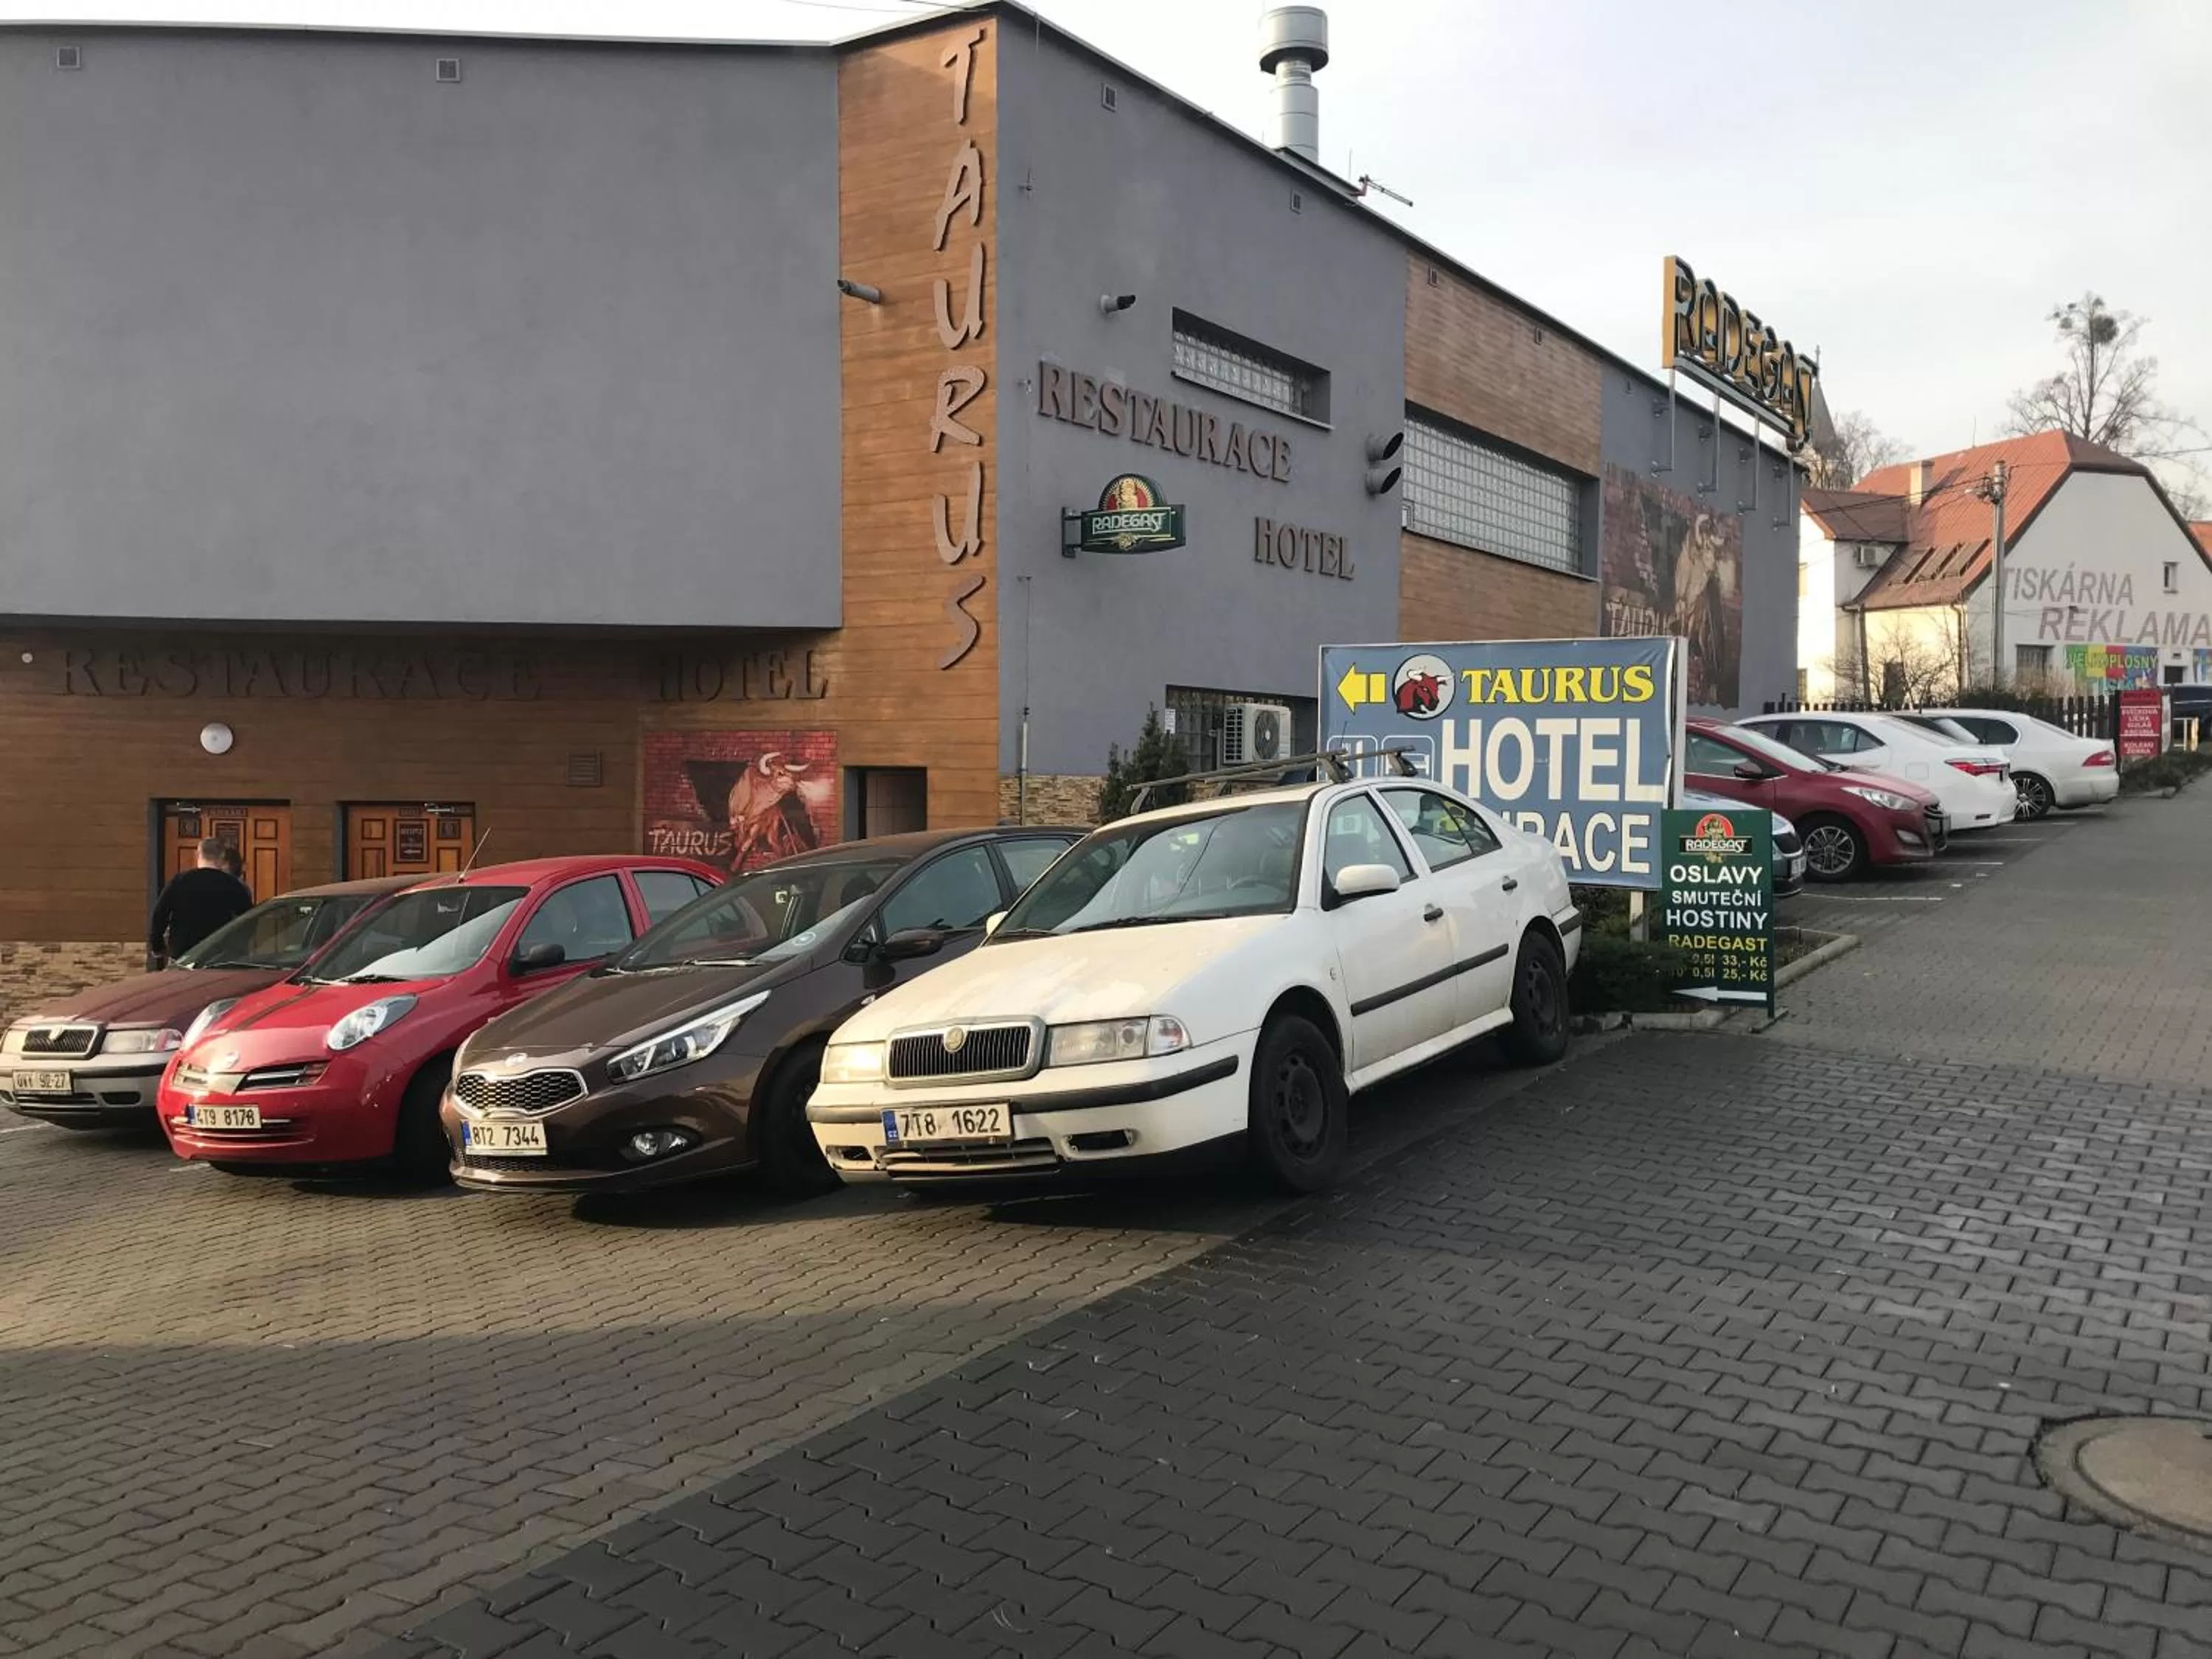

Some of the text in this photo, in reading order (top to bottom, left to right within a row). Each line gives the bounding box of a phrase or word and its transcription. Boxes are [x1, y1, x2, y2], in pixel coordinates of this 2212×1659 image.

[930, 28, 987, 670] TAURUS
[1038, 360, 1292, 484] RESTAURACE
[1093, 512, 1167, 535] RADEGAST
[1254, 517, 1355, 580] HOTEL
[2003, 562, 2134, 605] TISKÁRNA
[2039, 605, 2212, 646] REKLAMA
[58, 647, 544, 700] RESTAURACE
[649, 647, 828, 701] HOTEL
[1461, 664, 1655, 704] TAURUS
[1441, 717, 1664, 802] HOTEL
[648, 829, 734, 855] TAURUS
[1685, 838, 1747, 853] RADEGAST
[1670, 864, 1763, 884] OSLAVY
[1672, 888, 1761, 907] SMUTEČNÍ
[1666, 909, 1768, 930] HOSTINY
[1669, 934, 1768, 952] RADEGAST
[1750, 956, 1767, 967] Kč
[1750, 970, 1767, 981] Kč
[224, 1109, 254, 1126] 8178
[900, 1108, 1001, 1137] 7T8 1622
[503, 1126, 539, 1145] 7344
